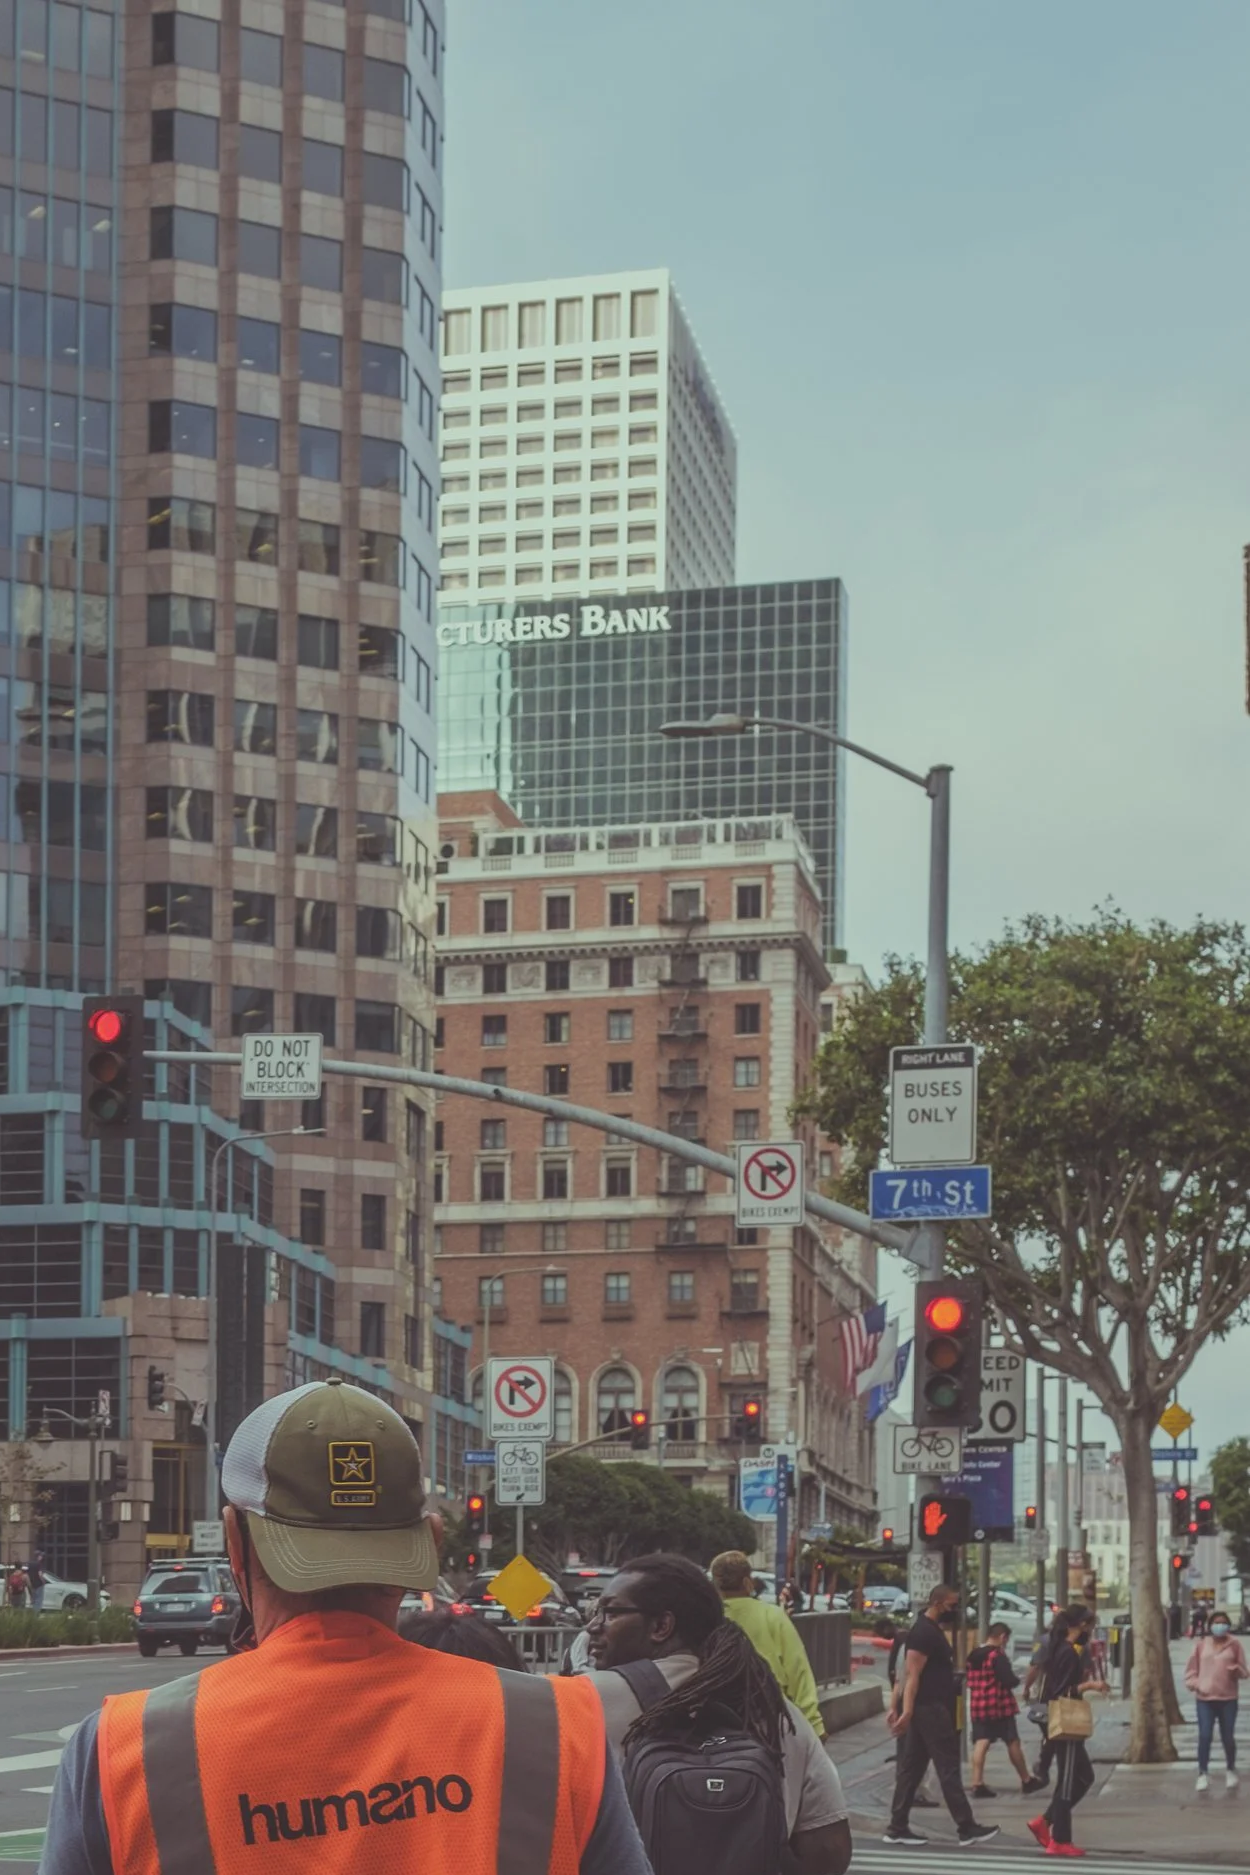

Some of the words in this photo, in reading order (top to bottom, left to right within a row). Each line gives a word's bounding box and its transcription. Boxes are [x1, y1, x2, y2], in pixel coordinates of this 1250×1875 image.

[580, 604, 672, 637] BANK
[254, 1040, 273, 1057] DO
[282, 1040, 310, 1057] NOT
[901, 1053, 935, 1065] RIGHT
[937, 1052, 966, 1064] LANE
[246, 1081, 316, 1093] INTERSECTION
[904, 1081, 962, 1098] BUSES
[908, 1106, 957, 1124] ONLY
[886, 1178, 932, 1210] 7th
[944, 1180, 975, 1206] St
[983, 1356, 1020, 1371] EED
[981, 1378, 1012, 1392] MIT
[493, 1423, 515, 1431] BIKES
[518, 1422, 548, 1431] EXEMPT
[502, 1467, 518, 1475] LEFT
[902, 1461, 921, 1471] BIKE
[927, 1461, 951, 1471] LANE
[238, 1773, 473, 1846] humano
